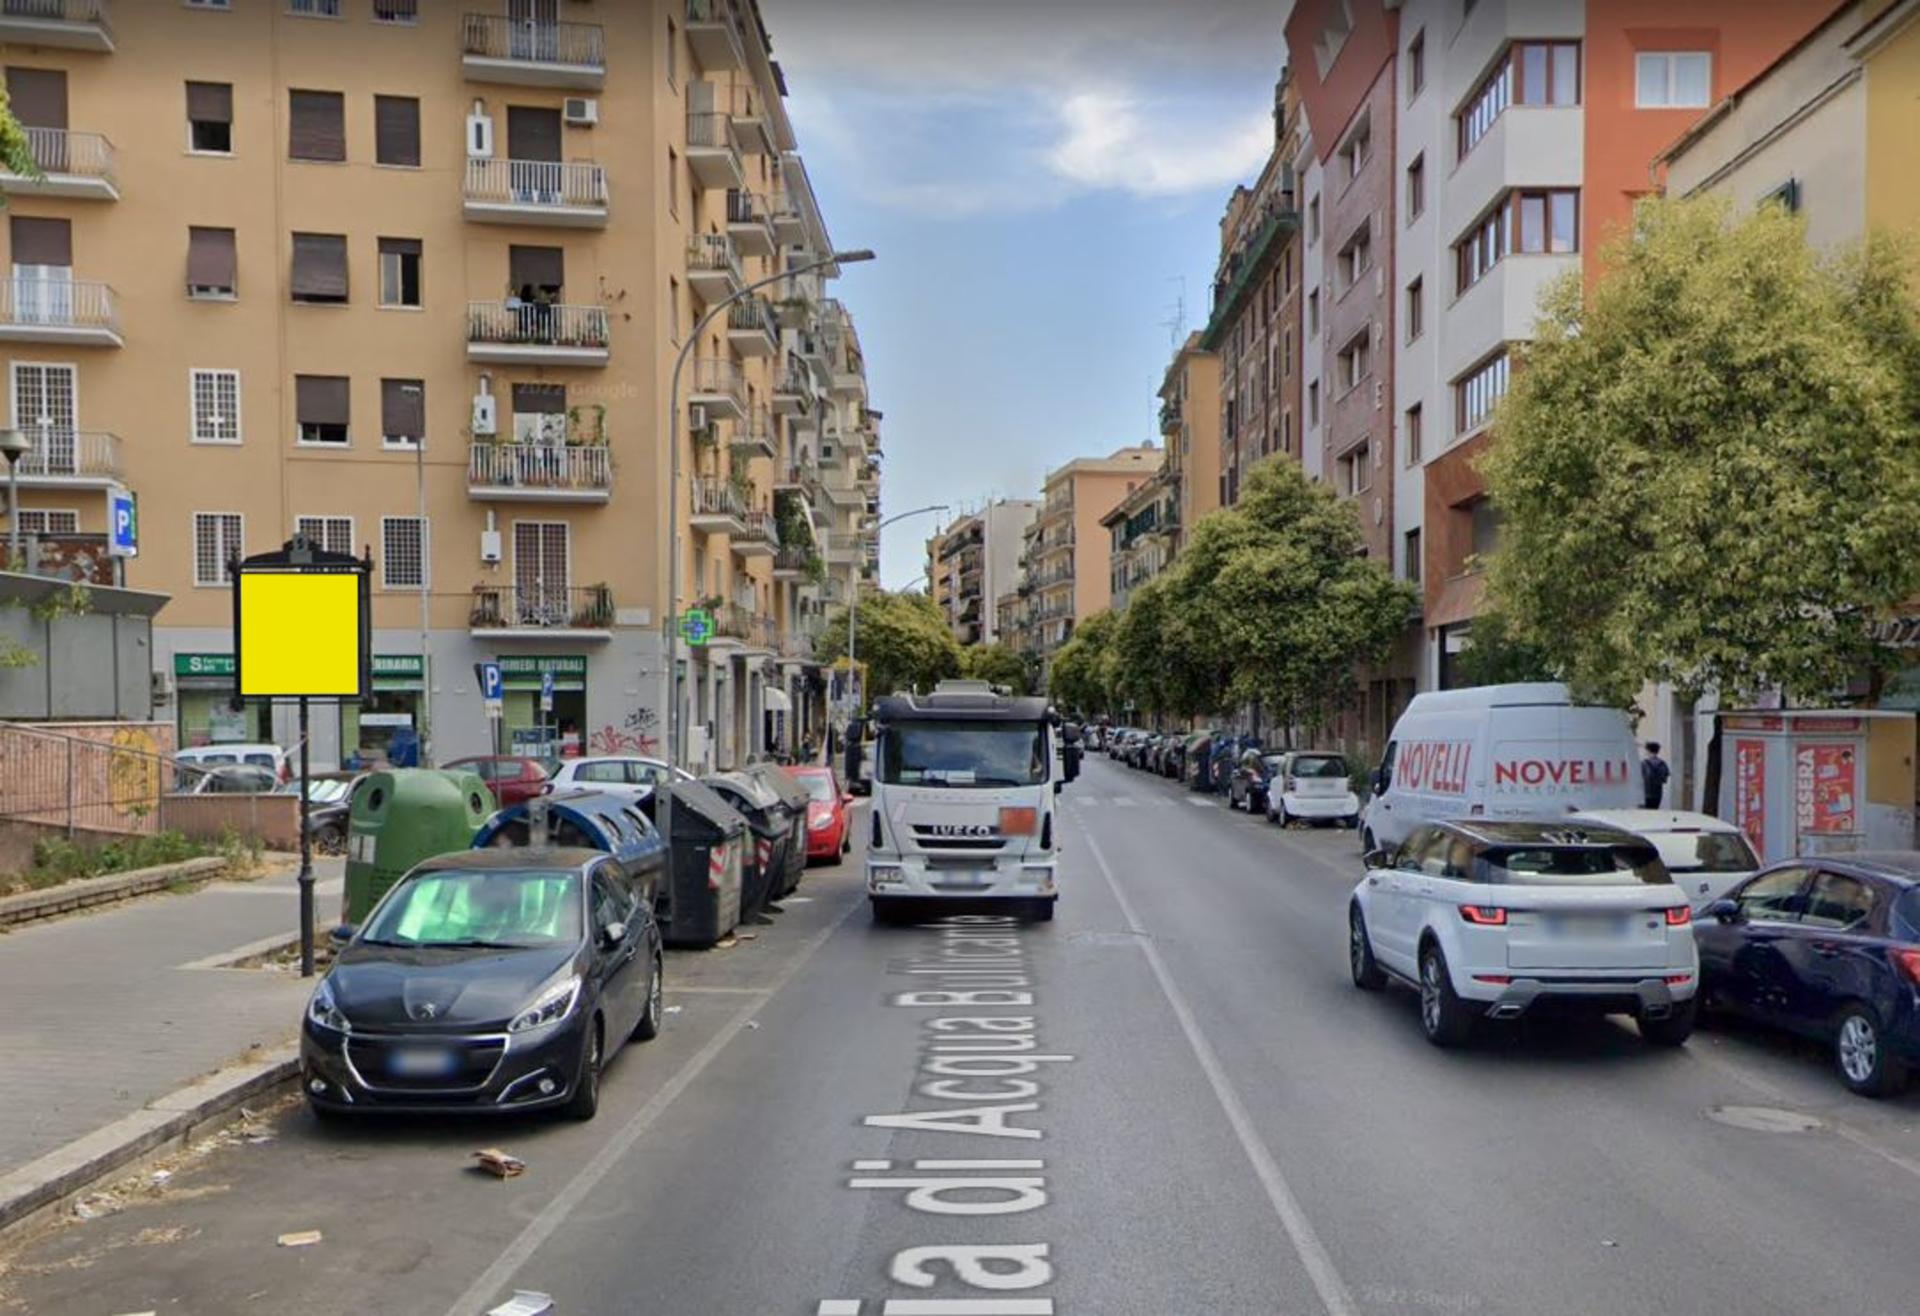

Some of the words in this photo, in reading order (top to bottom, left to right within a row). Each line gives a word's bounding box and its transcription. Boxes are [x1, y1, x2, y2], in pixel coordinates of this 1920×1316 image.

[119, 510, 129, 534] P
[486, 666, 498, 696] P
[1397, 742, 1471, 794] NOVELLI
[1495, 760, 1628, 785] NOVELLI
[1798, 748, 1815, 832] ESSERA
[932, 824, 991, 836] IVECO
